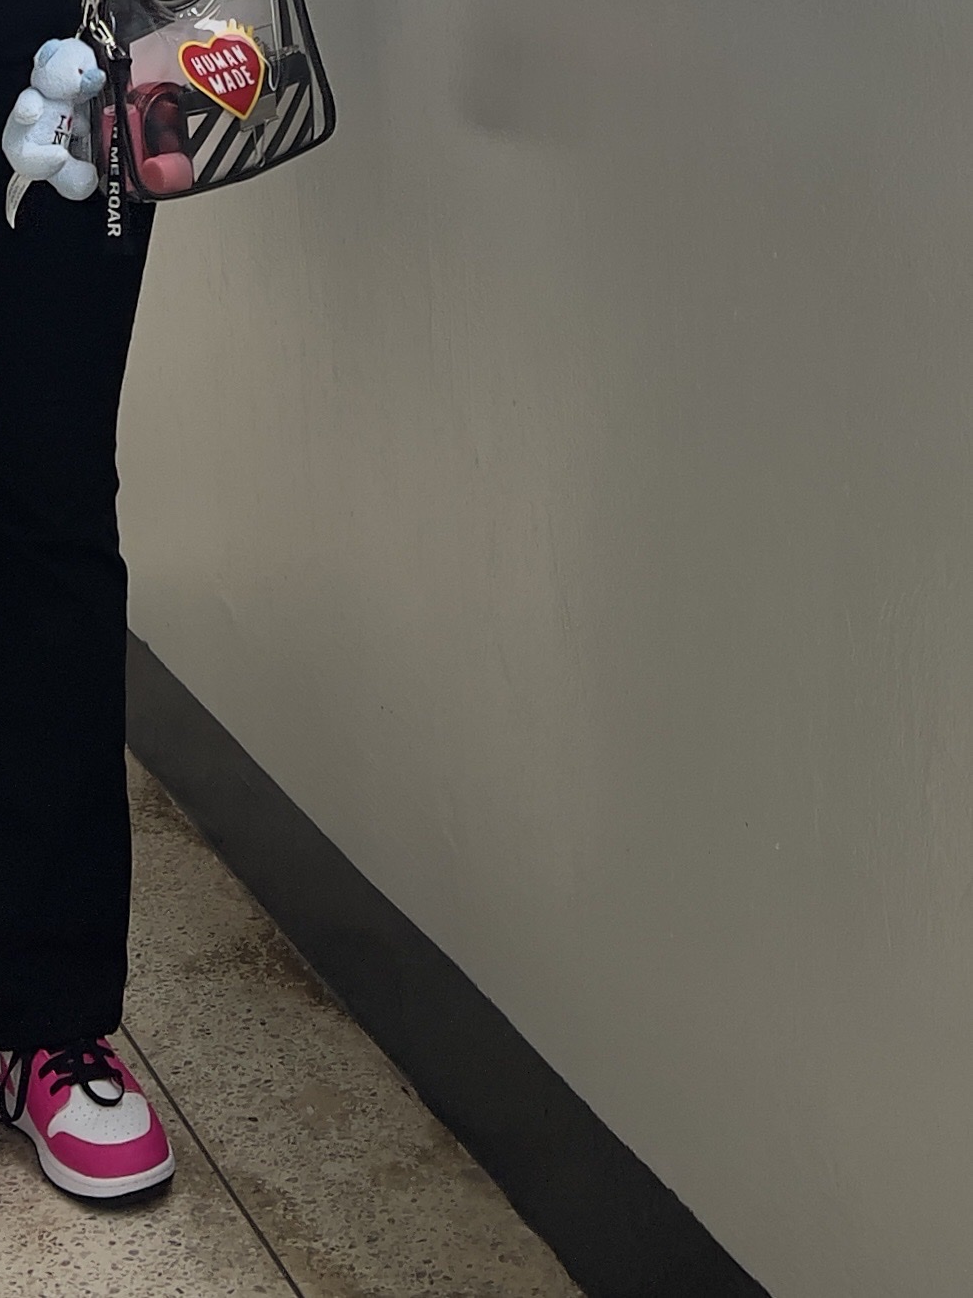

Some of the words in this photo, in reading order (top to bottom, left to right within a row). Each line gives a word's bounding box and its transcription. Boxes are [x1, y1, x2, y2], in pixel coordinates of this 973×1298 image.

[190, 44, 247, 76] HUMAN
[208, 65, 255, 95] MADE
[110, 146, 120, 176] ME
[107, 182, 122, 237] ROAR
